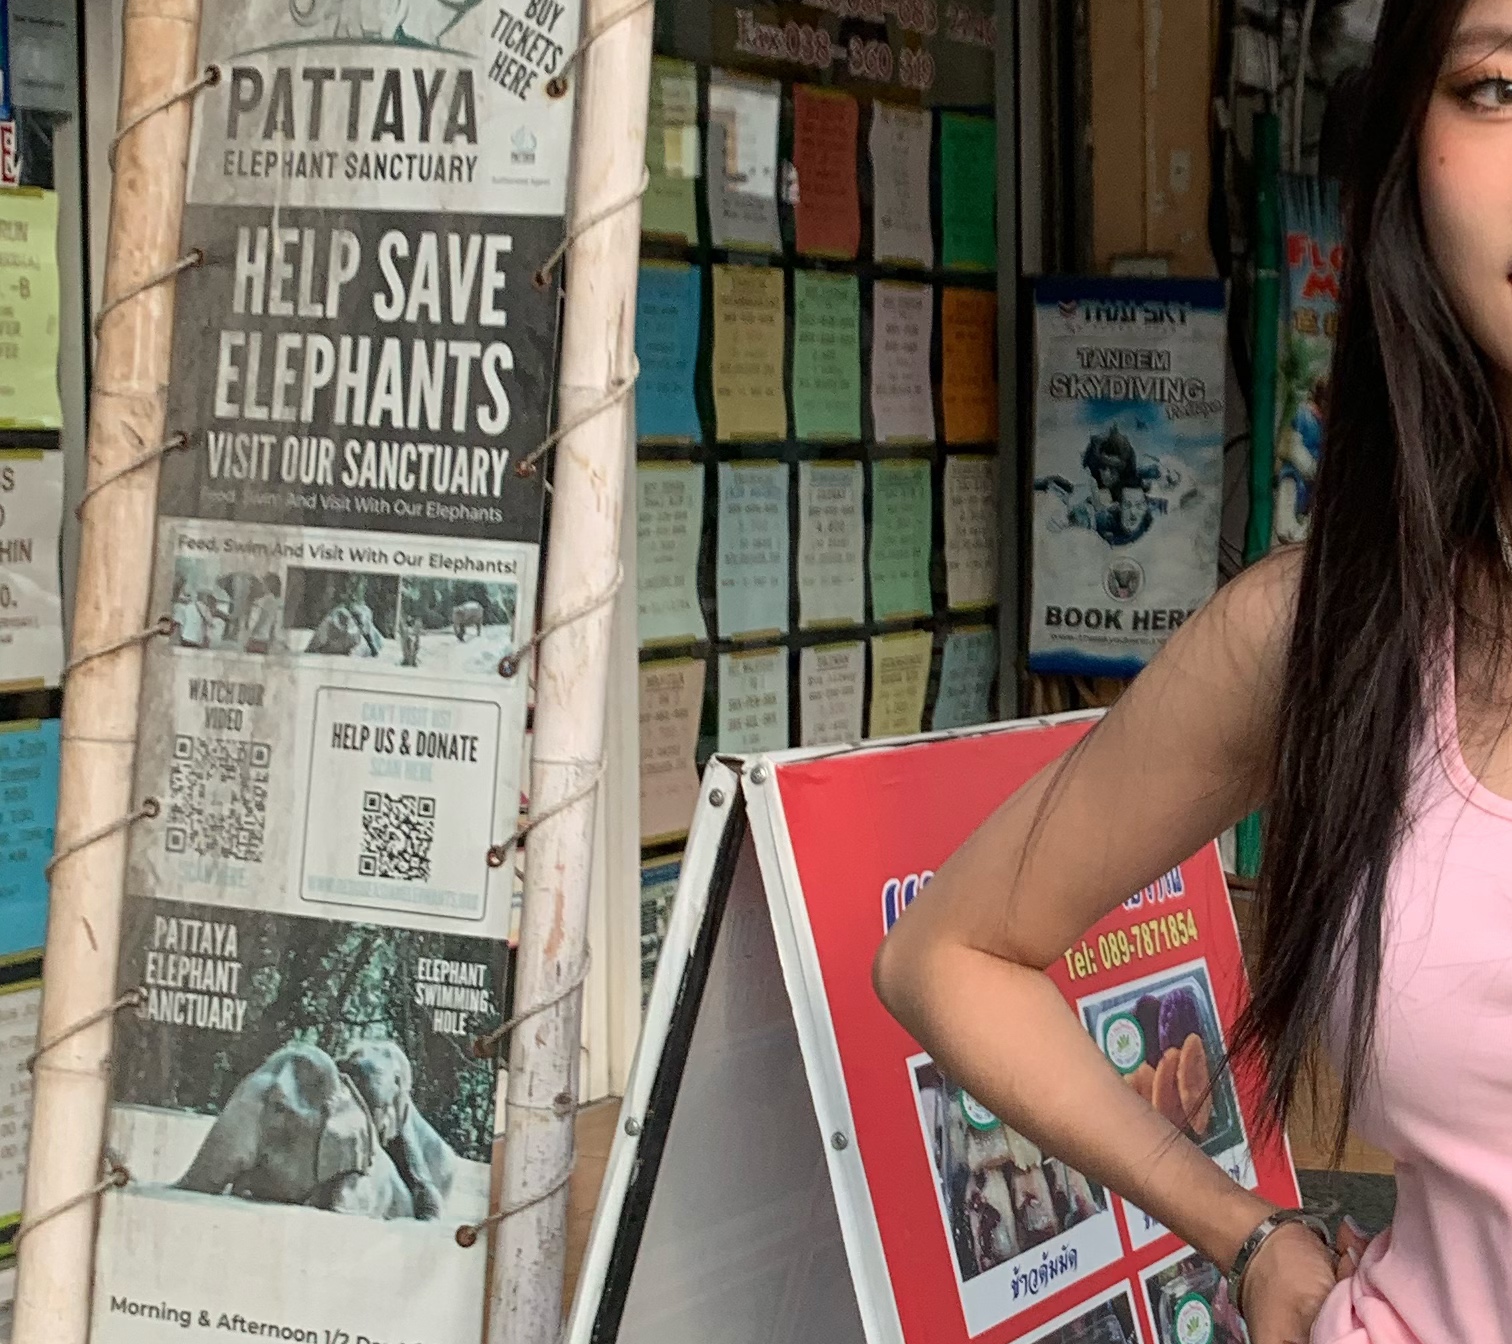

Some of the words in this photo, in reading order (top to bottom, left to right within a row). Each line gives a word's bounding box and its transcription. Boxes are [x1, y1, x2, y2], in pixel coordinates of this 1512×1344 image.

[490, 8, 563, 75] TICKETS
[487, 50, 539, 102] HERE
[226, 66, 479, 145] PATTAYA
[223, 150, 339, 180] ELEPHANT
[343, 153, 478, 183] SANCTUARY
[232, 225, 362, 320] HELP
[373, 229, 514, 327] SAVE
[1077, 346, 1172, 372] TANDEM
[213, 328, 515, 435] ELEPHANTS
[1049, 372, 1207, 404] SKYDIVING
[207, 430, 278, 481] VISIT
[280, 436, 335, 486] OUR
[341, 440, 510, 498] SANCTUARY
[321, 494, 351, 513] Visit
[355, 496, 391, 515] With
[396, 499, 423, 518] Our
[426, 501, 503, 524] Elephants
[223, 537, 268, 556] Swim
[272, 539, 304, 558] And
[308, 542, 344, 562] Visit
[349, 546, 388, 566] With
[393, 550, 423, 569] Our
[428, 553, 517, 576] Elephants!
[1045, 605, 1123, 630] BOOK
[189, 678, 234, 704] WATCH
[205, 707, 243, 732] VIDEO
[331, 722, 370, 752] HELP
[374, 726, 396, 755] US
[399, 729, 412, 756] &
[416, 729, 479, 763] DONATE
[154, 914, 239, 958] PATTAYA
[1064, 941, 1098, 980] Tel:
[1098, 908, 1198, 970] 089-7871854
[145, 952, 242, 995] ELEPHANT
[417, 957, 487, 988] ELEPHANT
[413, 983, 489, 1014] SWIMMING
[432, 1009, 467, 1035] HOLE
[1011, 1241, 1078, 1301] ข้าวต้มมัด
[110, 1295, 192, 1328] Morning
[198, 1310, 212, 1328] &
